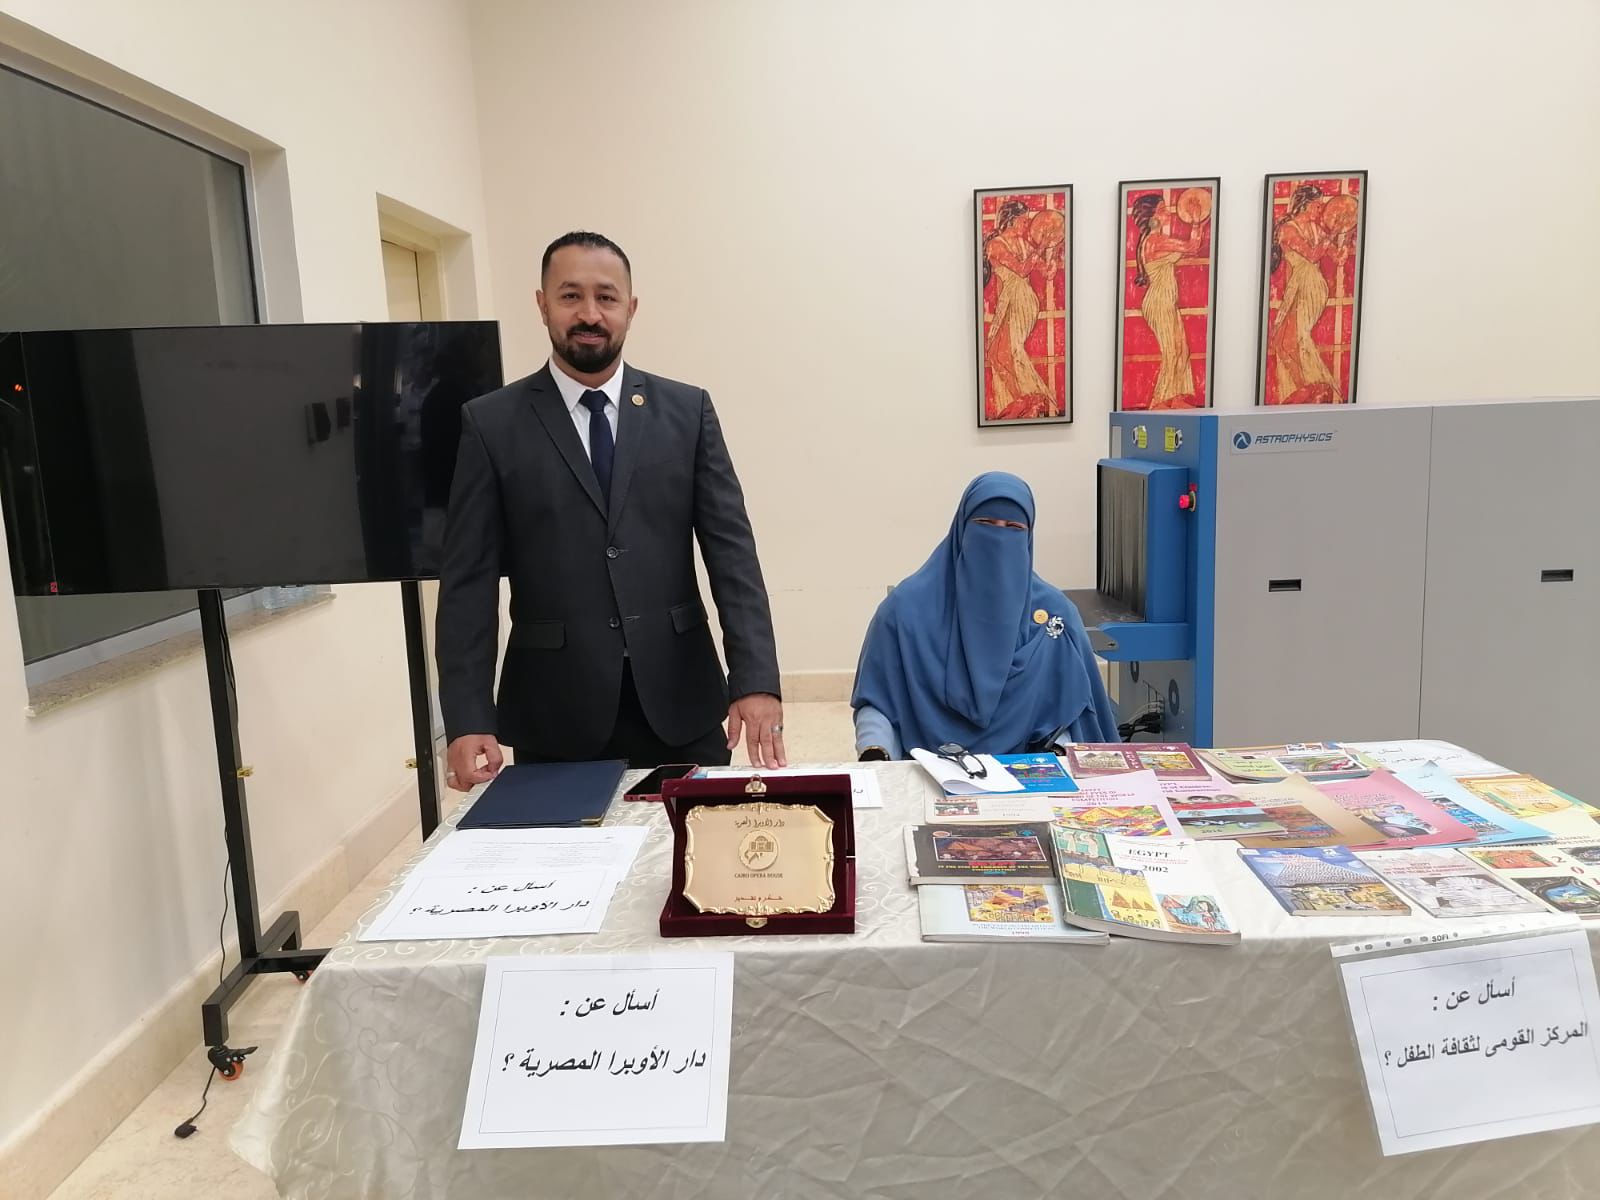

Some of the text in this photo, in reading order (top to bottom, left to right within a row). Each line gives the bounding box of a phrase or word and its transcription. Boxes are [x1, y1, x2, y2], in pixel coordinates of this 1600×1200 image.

[1254, 432, 1334, 445] ASTROPHYSICS
[1128, 848, 1170, 859] EGYPT
[1142, 864, 1169, 873] 2002
[480, 885, 508, 894] عن
[425, 904, 499, 917] المصرية
[559, 899, 590, 911] دار
[1445, 990, 1471, 1011] عن
[1477, 976, 1515, 1005] أسأل
[575, 996, 606, 1018] عن
[612, 988, 660, 1016] أسأل
[1485, 1028, 1535, 1058] القومى
[1540, 1021, 1588, 1048] المركز
[1397, 1043, 1436, 1069] الطفل
[1440, 1035, 1481, 1057] لثقافة
[519, 1047, 602, 1078] المصرية
[608, 1044, 671, 1076] الأوبرا
[673, 1049, 707, 1074] دار
